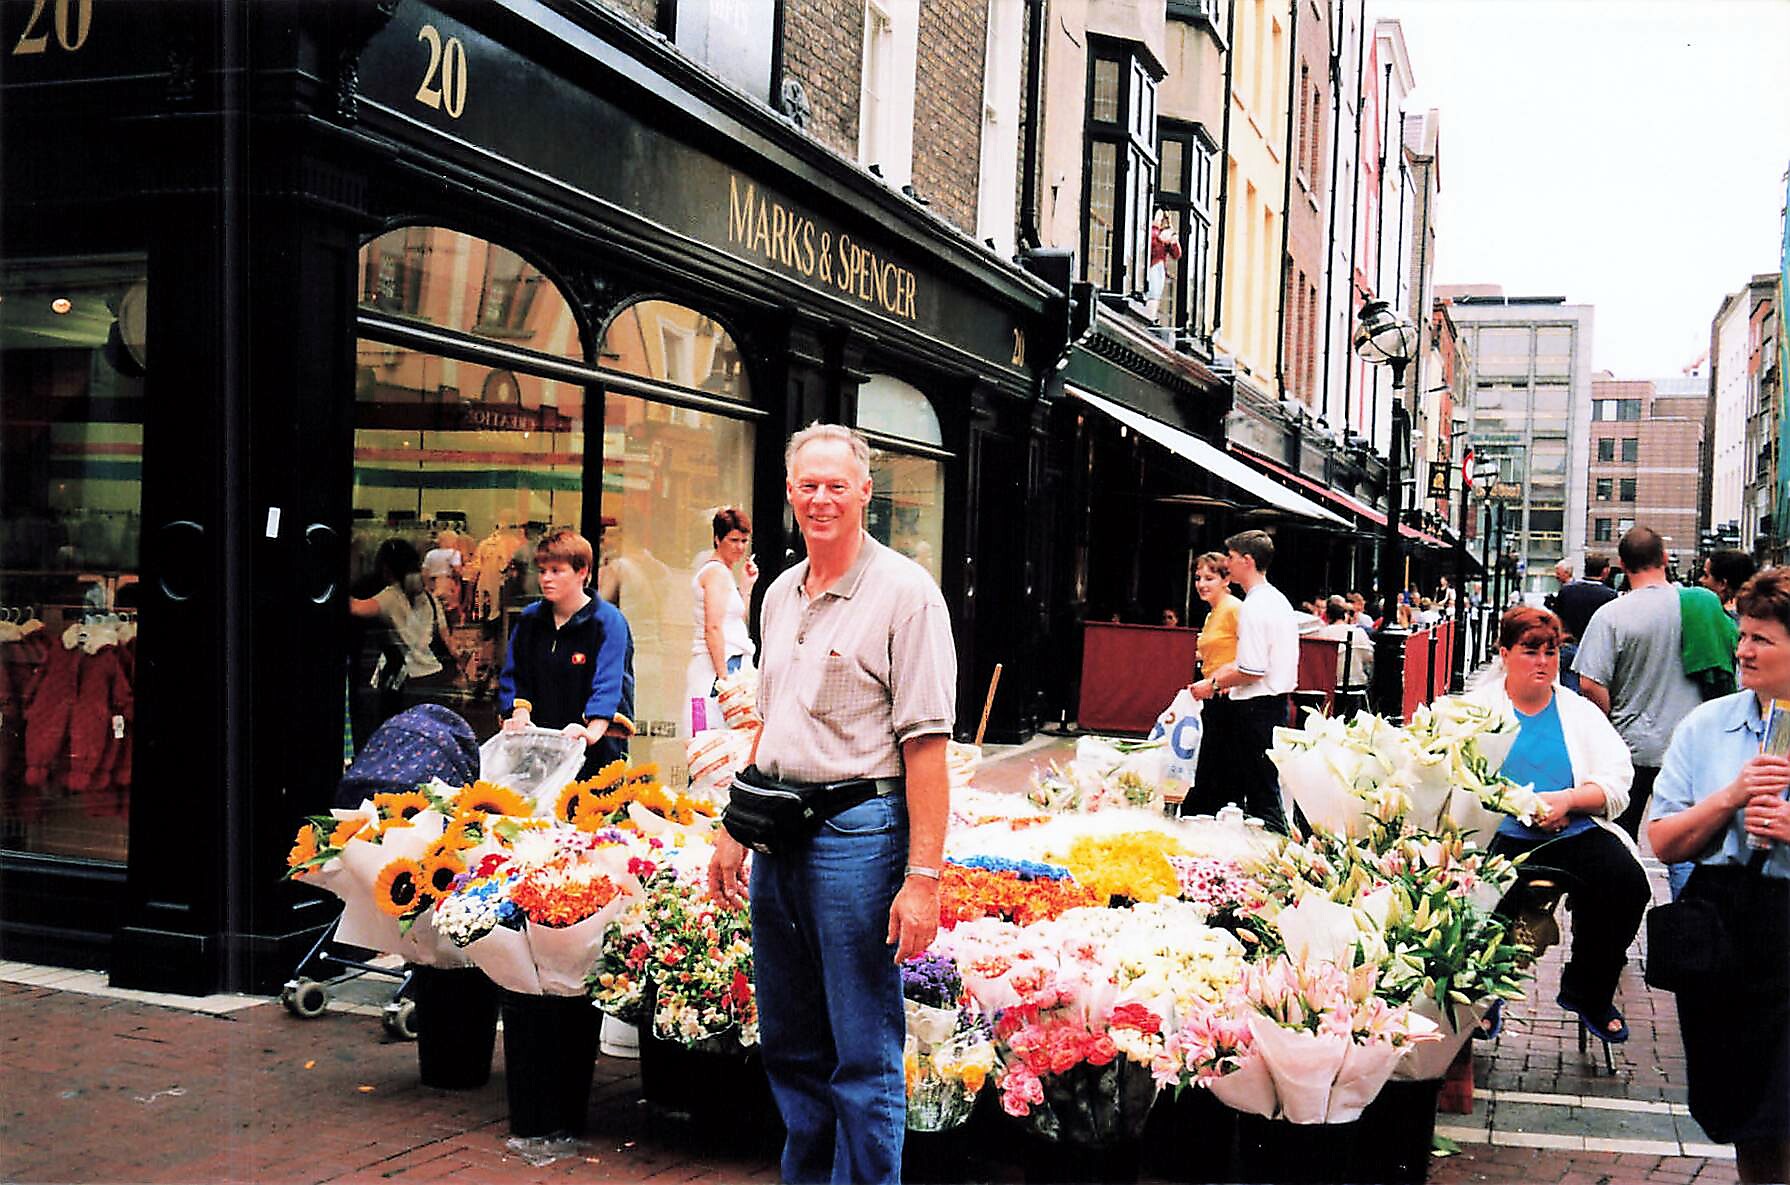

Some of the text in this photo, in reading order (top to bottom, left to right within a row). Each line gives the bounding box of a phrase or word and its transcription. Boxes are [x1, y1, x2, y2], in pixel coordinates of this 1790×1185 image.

[13, 0, 92, 53] 20
[416, 25, 467, 118] 20
[728, 175, 917, 320] MARKS & SPENCER
[1011, 327, 1025, 368] 20
